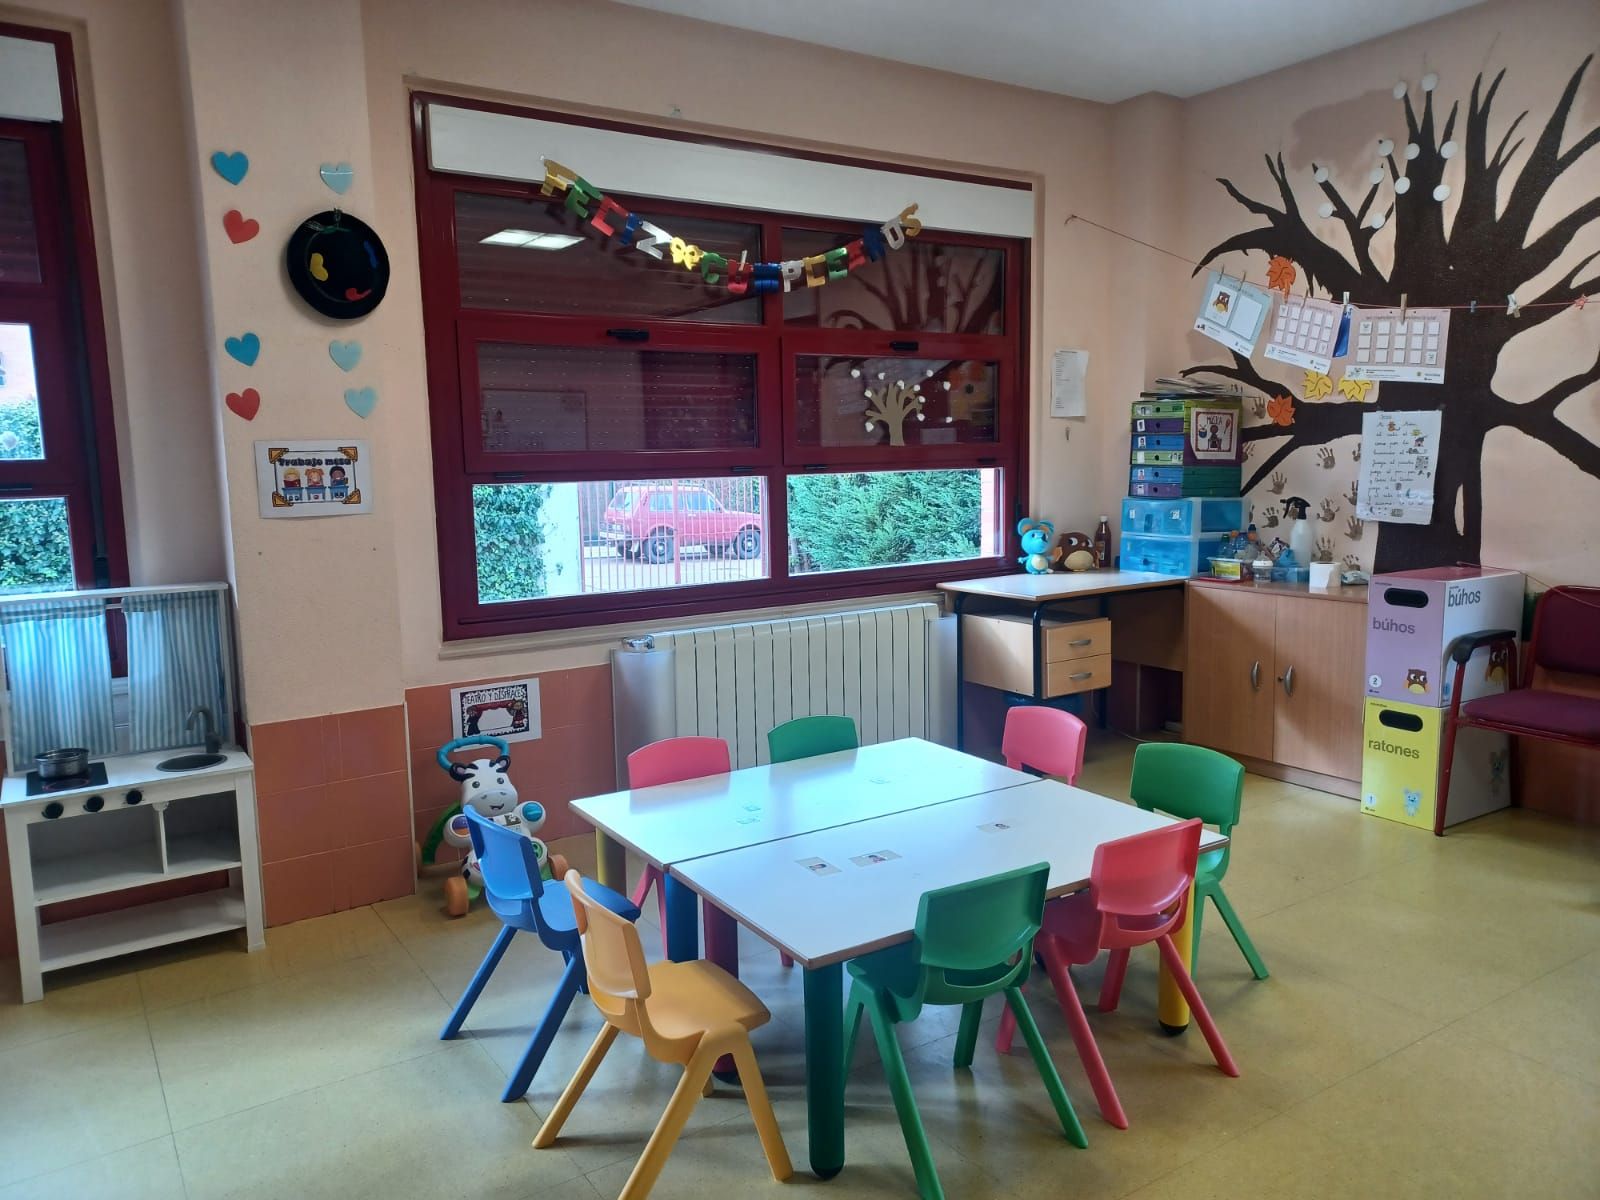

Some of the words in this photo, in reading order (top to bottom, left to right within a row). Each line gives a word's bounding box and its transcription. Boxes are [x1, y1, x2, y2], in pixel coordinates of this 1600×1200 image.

[1448, 588, 1481, 607] búhos
[1372, 617, 1416, 634] búhos
[464, 693, 486, 705] TEATRO
[1368, 738, 1420, 760] ratones
